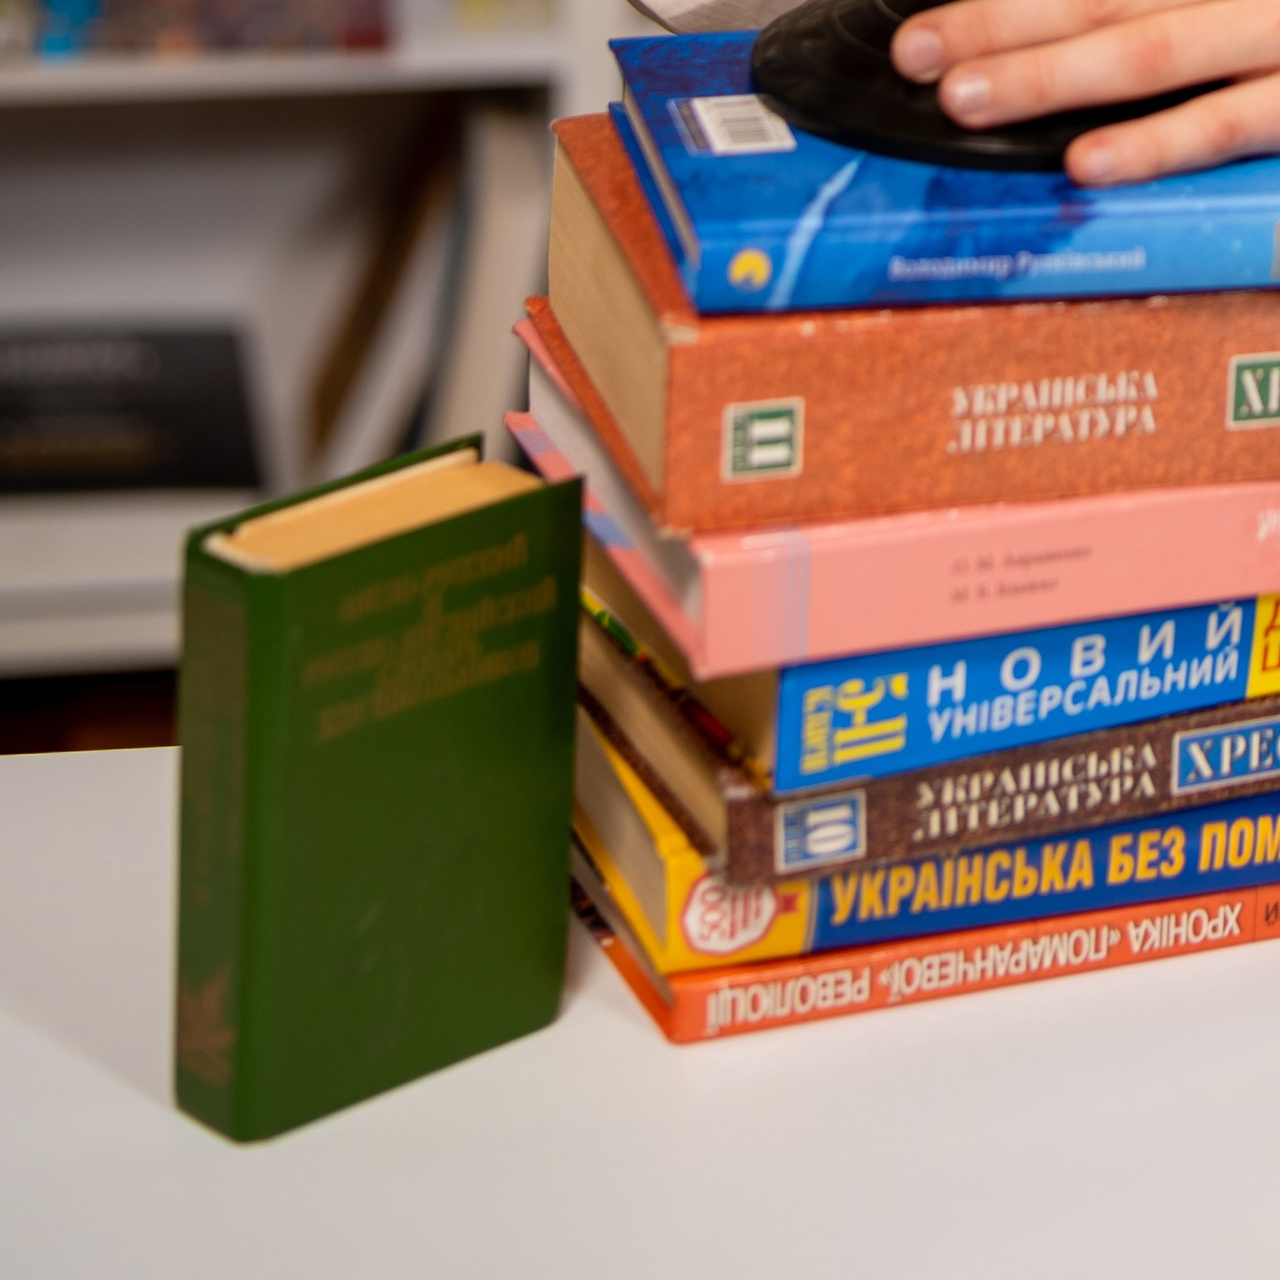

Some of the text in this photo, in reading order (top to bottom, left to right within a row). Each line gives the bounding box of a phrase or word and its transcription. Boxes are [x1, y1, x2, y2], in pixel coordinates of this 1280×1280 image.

[951, 368, 1158, 417] УКРАЇНСЬКА
[946, 403, 1156, 455] ЛІТЕРАТУРА
[926, 601, 1243, 708] НОВИЙ
[928, 645, 1238, 743] УНІВЕРСАЛЬНИЙ
[912, 771, 1156, 841] ЛІТЕРАТУРА
[917, 741, 1157, 809] УКРАЇНСЬКА
[805, 803, 855, 857] 10
[830, 838, 1094, 925] УКРАЇНСЬКА
[1106, 824, 1185, 886] БЕЗ
[700, 885, 728, 941] 500
[1129, 903, 1242, 953] ХРОНІКА
[878, 925, 1122, 1002] «ПОМАРАНЧЕВОЇ»
[706, 966, 871, 1036] РЕВОЛЮЦІЇ
